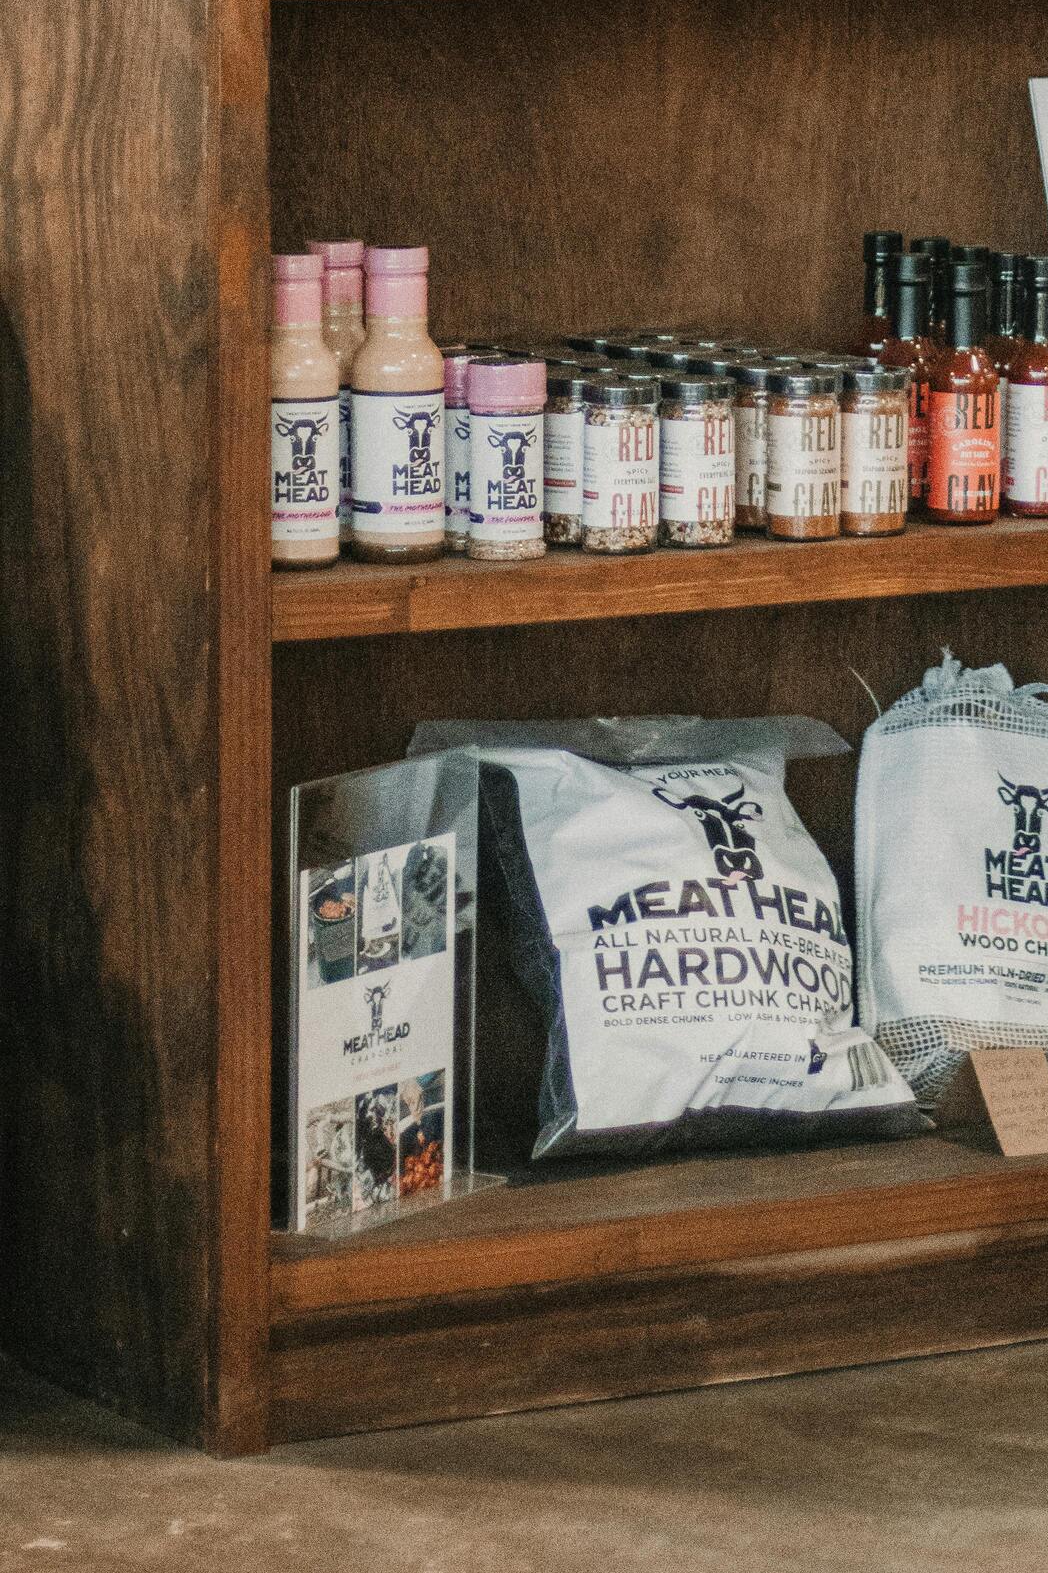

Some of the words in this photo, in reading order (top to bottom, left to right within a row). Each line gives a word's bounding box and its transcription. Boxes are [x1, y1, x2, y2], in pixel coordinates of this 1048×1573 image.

[955, 391, 994, 429] RED
[801, 416, 836, 452] RED
[868, 414, 904, 450] RED
[618, 424, 654, 462] RED
[392, 461, 440, 479] MEAT
[626, 467, 649, 476] SPICY
[809, 458, 830, 466] SPICY
[275, 470, 328, 486] MEAT
[392, 479, 441, 496] HEAD
[488, 478, 536, 495] MEAT
[275, 486, 329, 503] HEAD
[488, 494, 537, 510] HEAD
[795, 482, 838, 516] CLAY
[861, 479, 905, 513] CLAY
[947, 473, 995, 511] CLAY
[491, 516, 505, 524] THE
[505, 515, 535, 524] FOUNDER
[611, 492, 656, 529] CLAY
[657, 769, 701, 785] YOUR
[586, 878, 739, 932] MEAT
[594, 931, 638, 949] ALL
[646, 927, 753, 945] NATURAL
[957, 932, 1019, 952] WOOD
[594, 946, 851, 1012] HARDWOOD
[918, 963, 985, 976] PREMIUM
[987, 965, 1046, 984] KILN-DRIED
[602, 991, 686, 1014] CRAFT
[696, 989, 780, 1008] CHUNK
[604, 1017, 634, 1027] BOLD
[636, 1015, 670, 1025] DENSE
[671, 1014, 714, 1023] CHUNKS
[728, 1013, 751, 1022] LOW
[783, 1015, 797, 1023] NO
[794, 1053, 806, 1063] IN
[737, 1075, 767, 1085] CUBIC
[768, 1077, 804, 1088] INCHES
